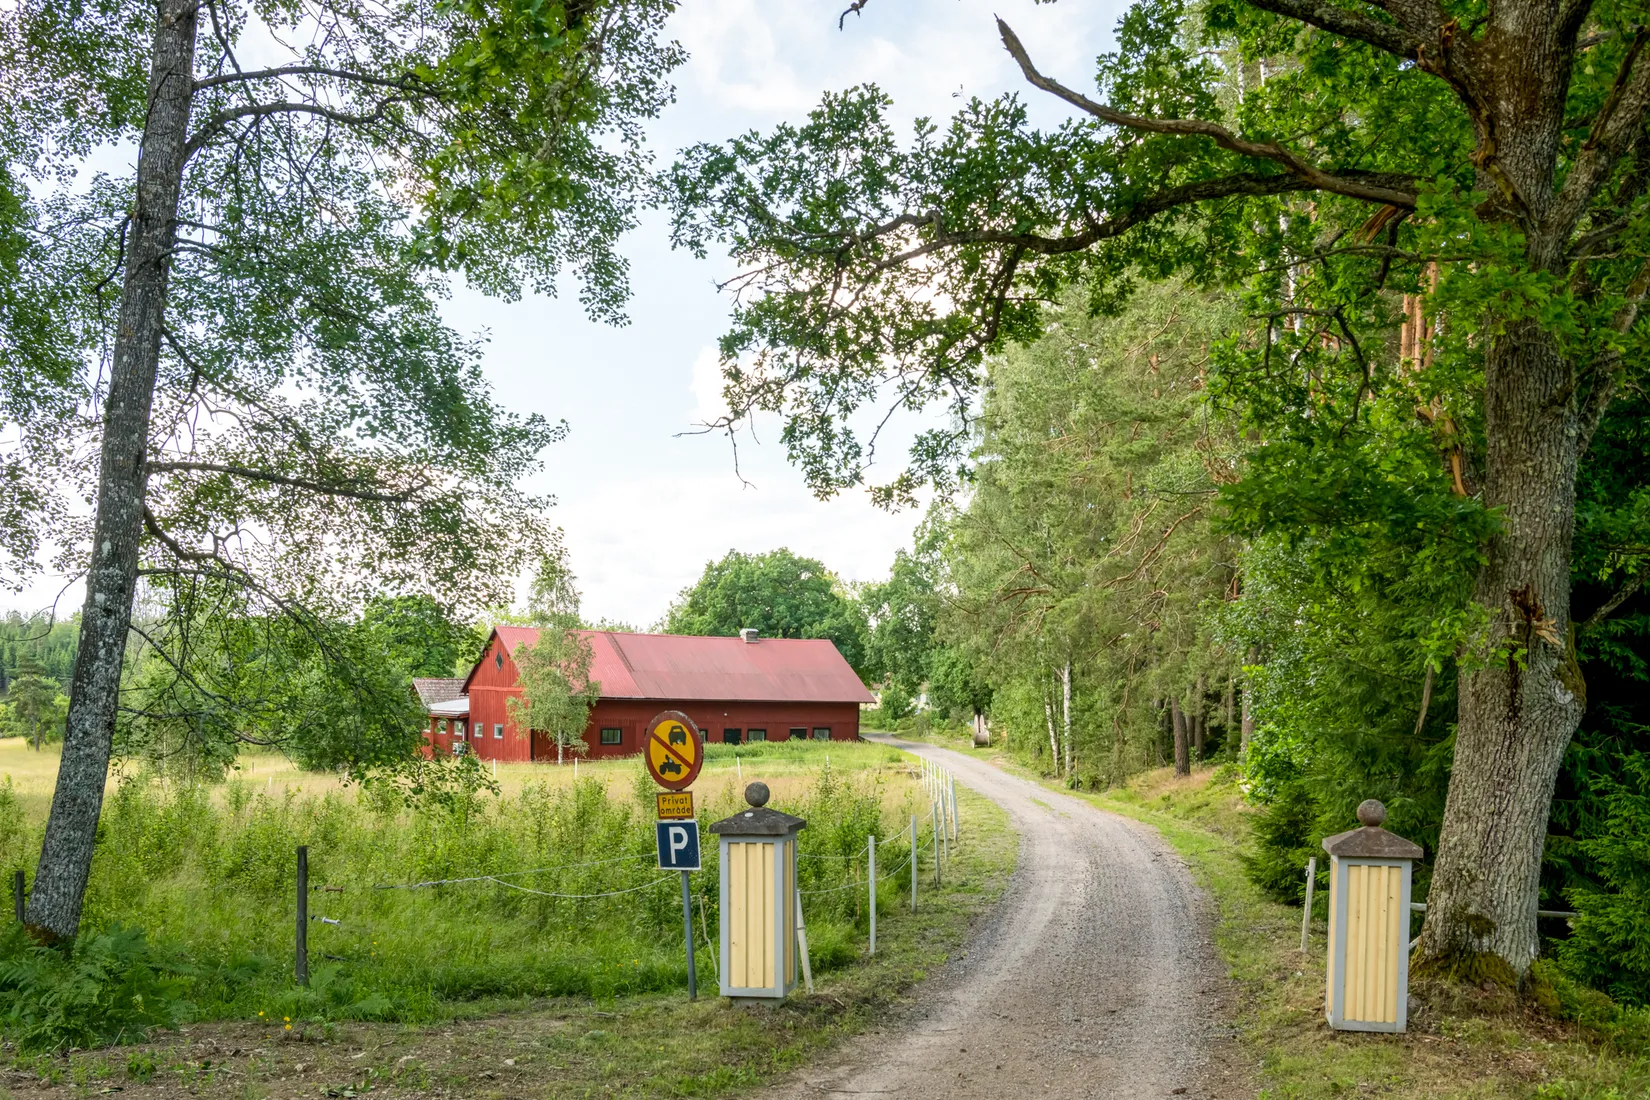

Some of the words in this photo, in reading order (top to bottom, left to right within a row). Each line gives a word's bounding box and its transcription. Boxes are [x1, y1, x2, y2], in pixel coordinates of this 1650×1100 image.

[662, 796, 688, 805] Privat
[660, 807, 691, 815] område
[669, 826, 688, 864] P
